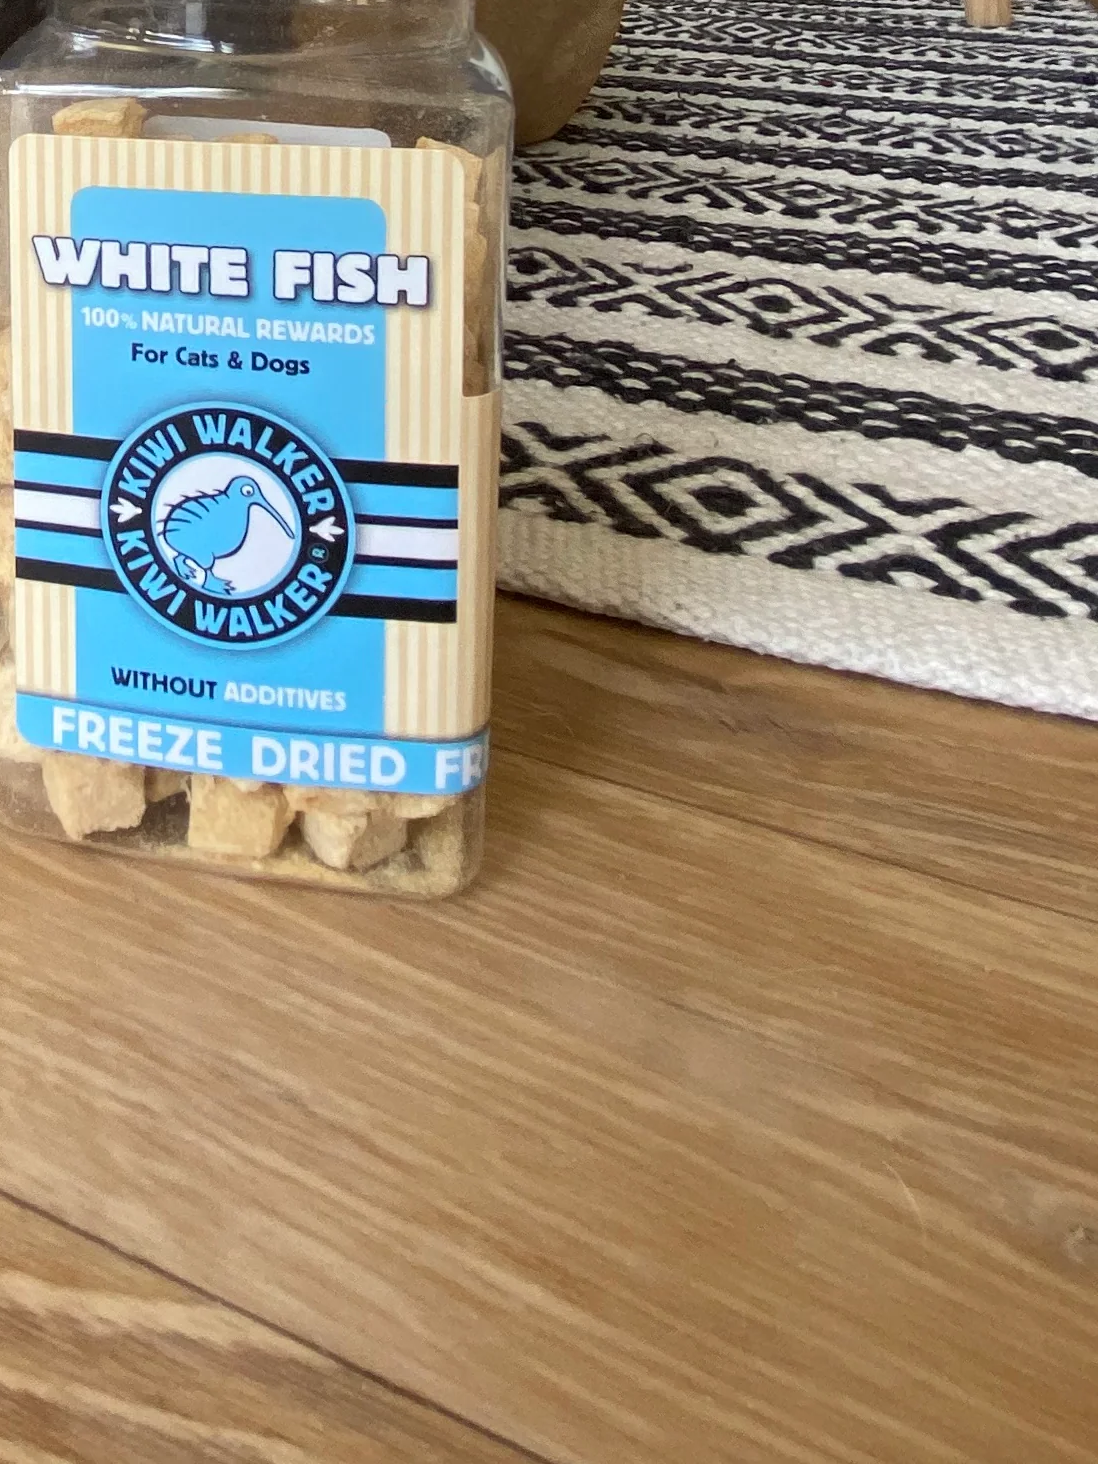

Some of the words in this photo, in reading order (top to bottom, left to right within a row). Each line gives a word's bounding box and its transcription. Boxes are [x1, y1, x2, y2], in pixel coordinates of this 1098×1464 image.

[32, 235, 250, 297] WHITE
[273, 248, 430, 306] FISH
[81, 307, 138, 330] 100%
[142, 311, 250, 338] NATURAL
[256, 320, 375, 345] REWARDS
[131, 343, 168, 366] For
[175, 347, 219, 369] Cats
[228, 352, 243, 370] &
[251, 351, 310, 375] Dogs
[118, 423, 187, 500] KIWI
[192, 413, 336, 516] WALKER
[117, 529, 186, 616] KIWI
[193, 563, 333, 637] WALKER
[111, 666, 218, 700] WITHOUT
[223, 681, 347, 712] ADDITIVES
[52, 706, 223, 770] FREEZE
[252, 739, 406, 786] DRIED
